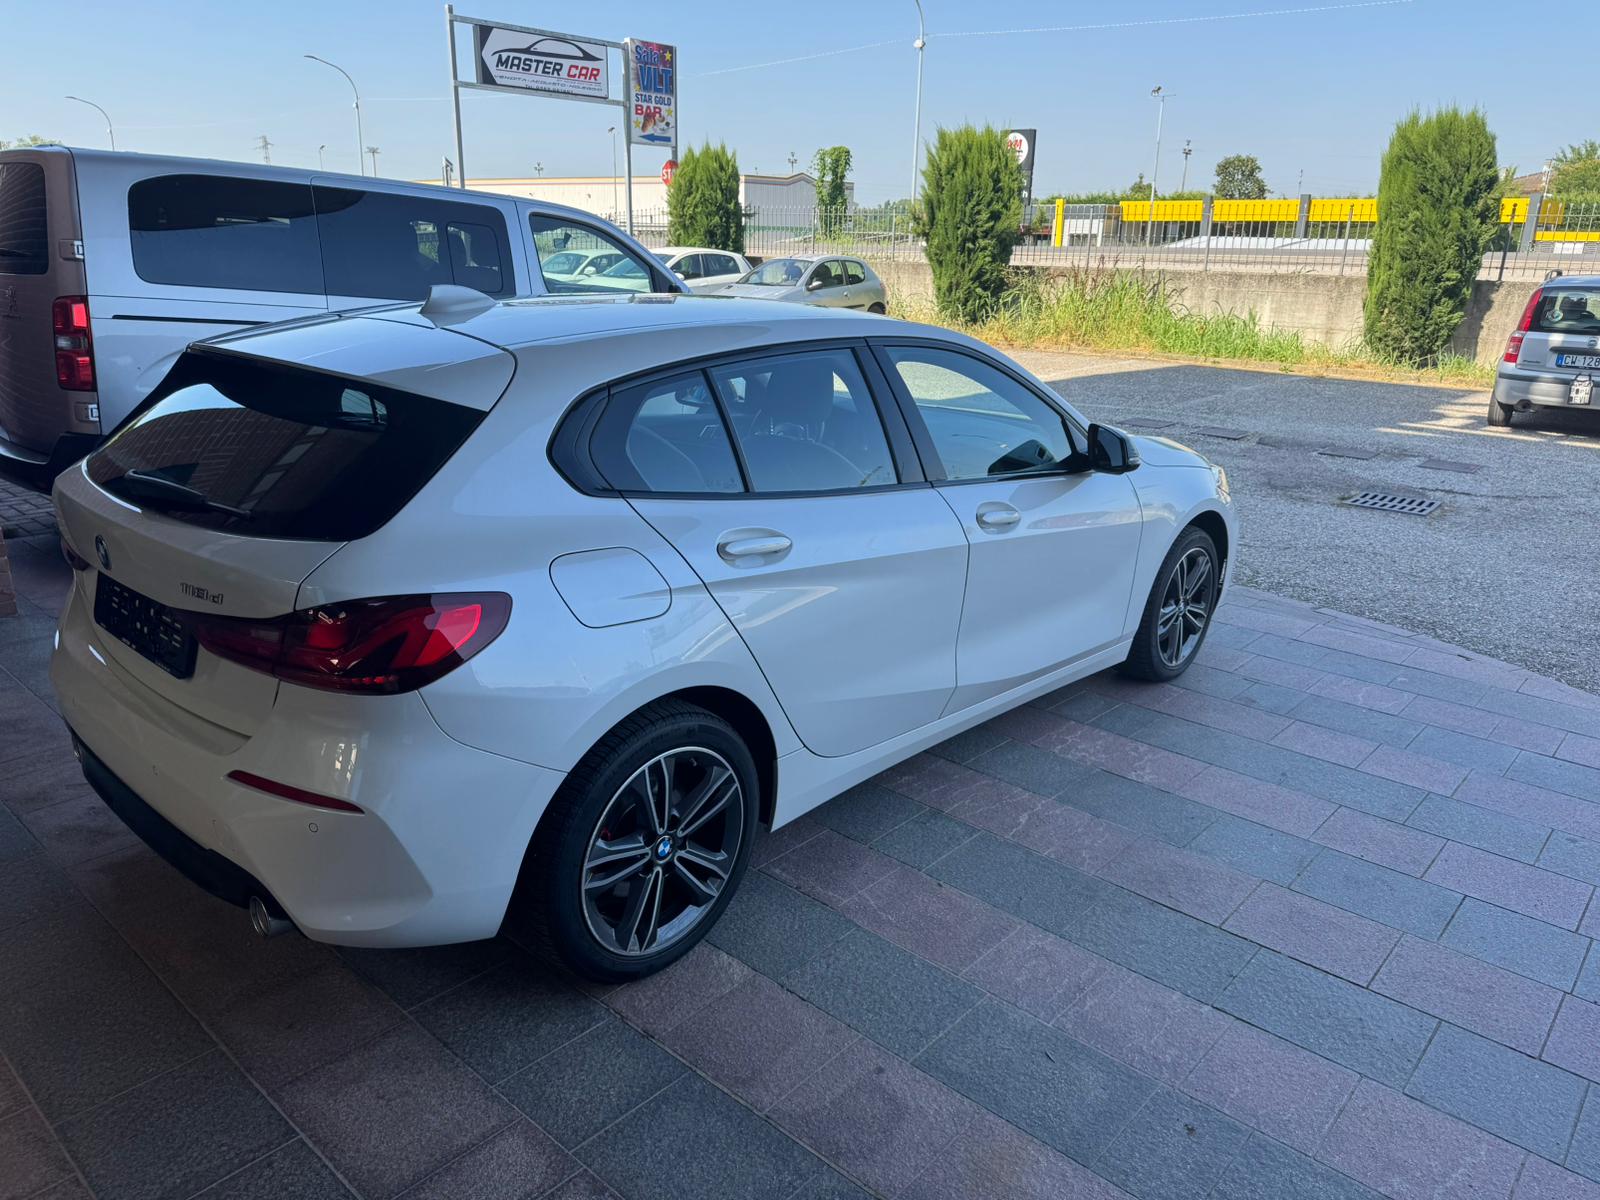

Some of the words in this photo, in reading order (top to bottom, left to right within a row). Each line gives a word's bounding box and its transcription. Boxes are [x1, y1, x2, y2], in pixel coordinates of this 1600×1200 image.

[496, 53, 564, 76] MASTER
[567, 64, 601, 81] CAR
[638, 64, 673, 95] VLT
[635, 93, 653, 104] STAR
[654, 96, 672, 106] GOLD
[635, 104, 662, 117] BAR
[1563, 355, 1578, 366] CW
